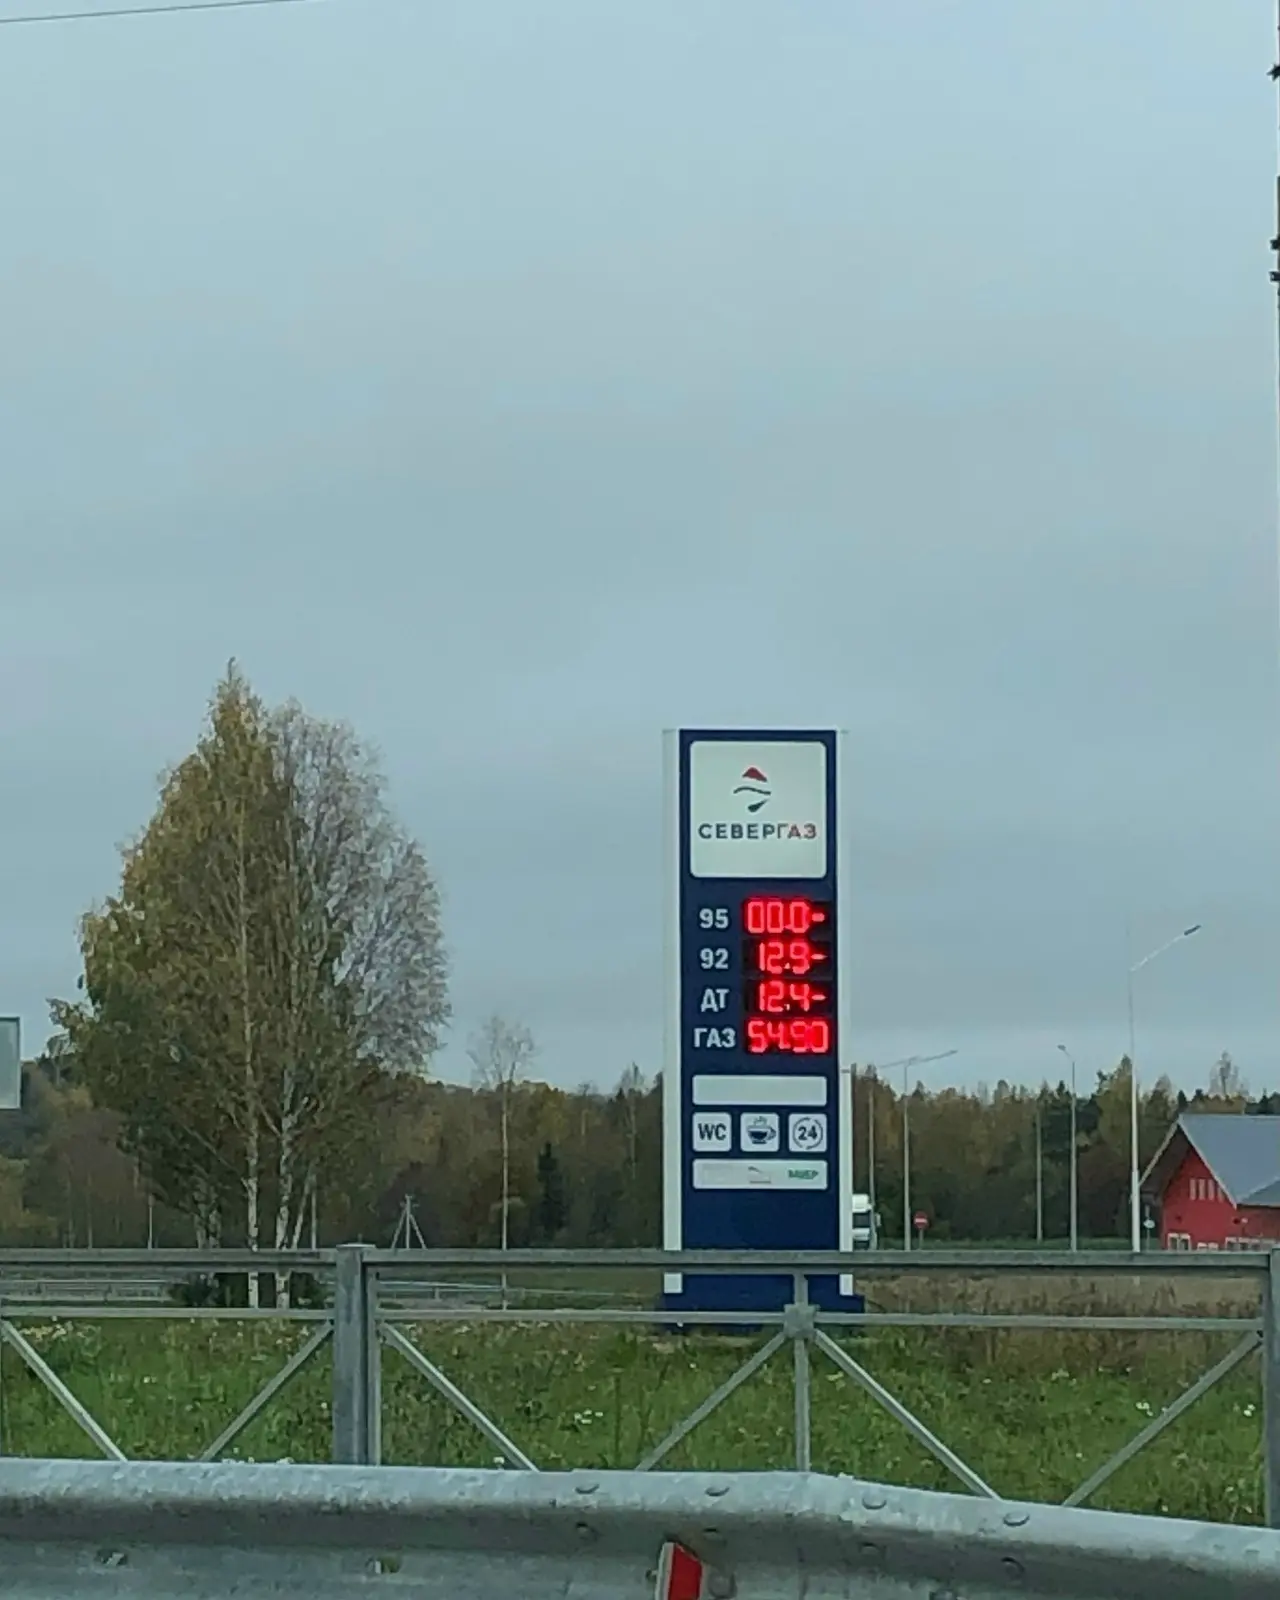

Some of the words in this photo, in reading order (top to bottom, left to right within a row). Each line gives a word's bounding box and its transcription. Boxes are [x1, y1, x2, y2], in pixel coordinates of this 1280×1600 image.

[698, 823, 818, 839] СЕВЕРГАЗ
[699, 909, 729, 929] 95
[700, 949, 729, 969] 92
[700, 989, 729, 1012] ДТ
[694, 1028, 736, 1048] ГАЗ
[698, 1123, 727, 1141] WC
[798, 1125, 818, 1141] 24
